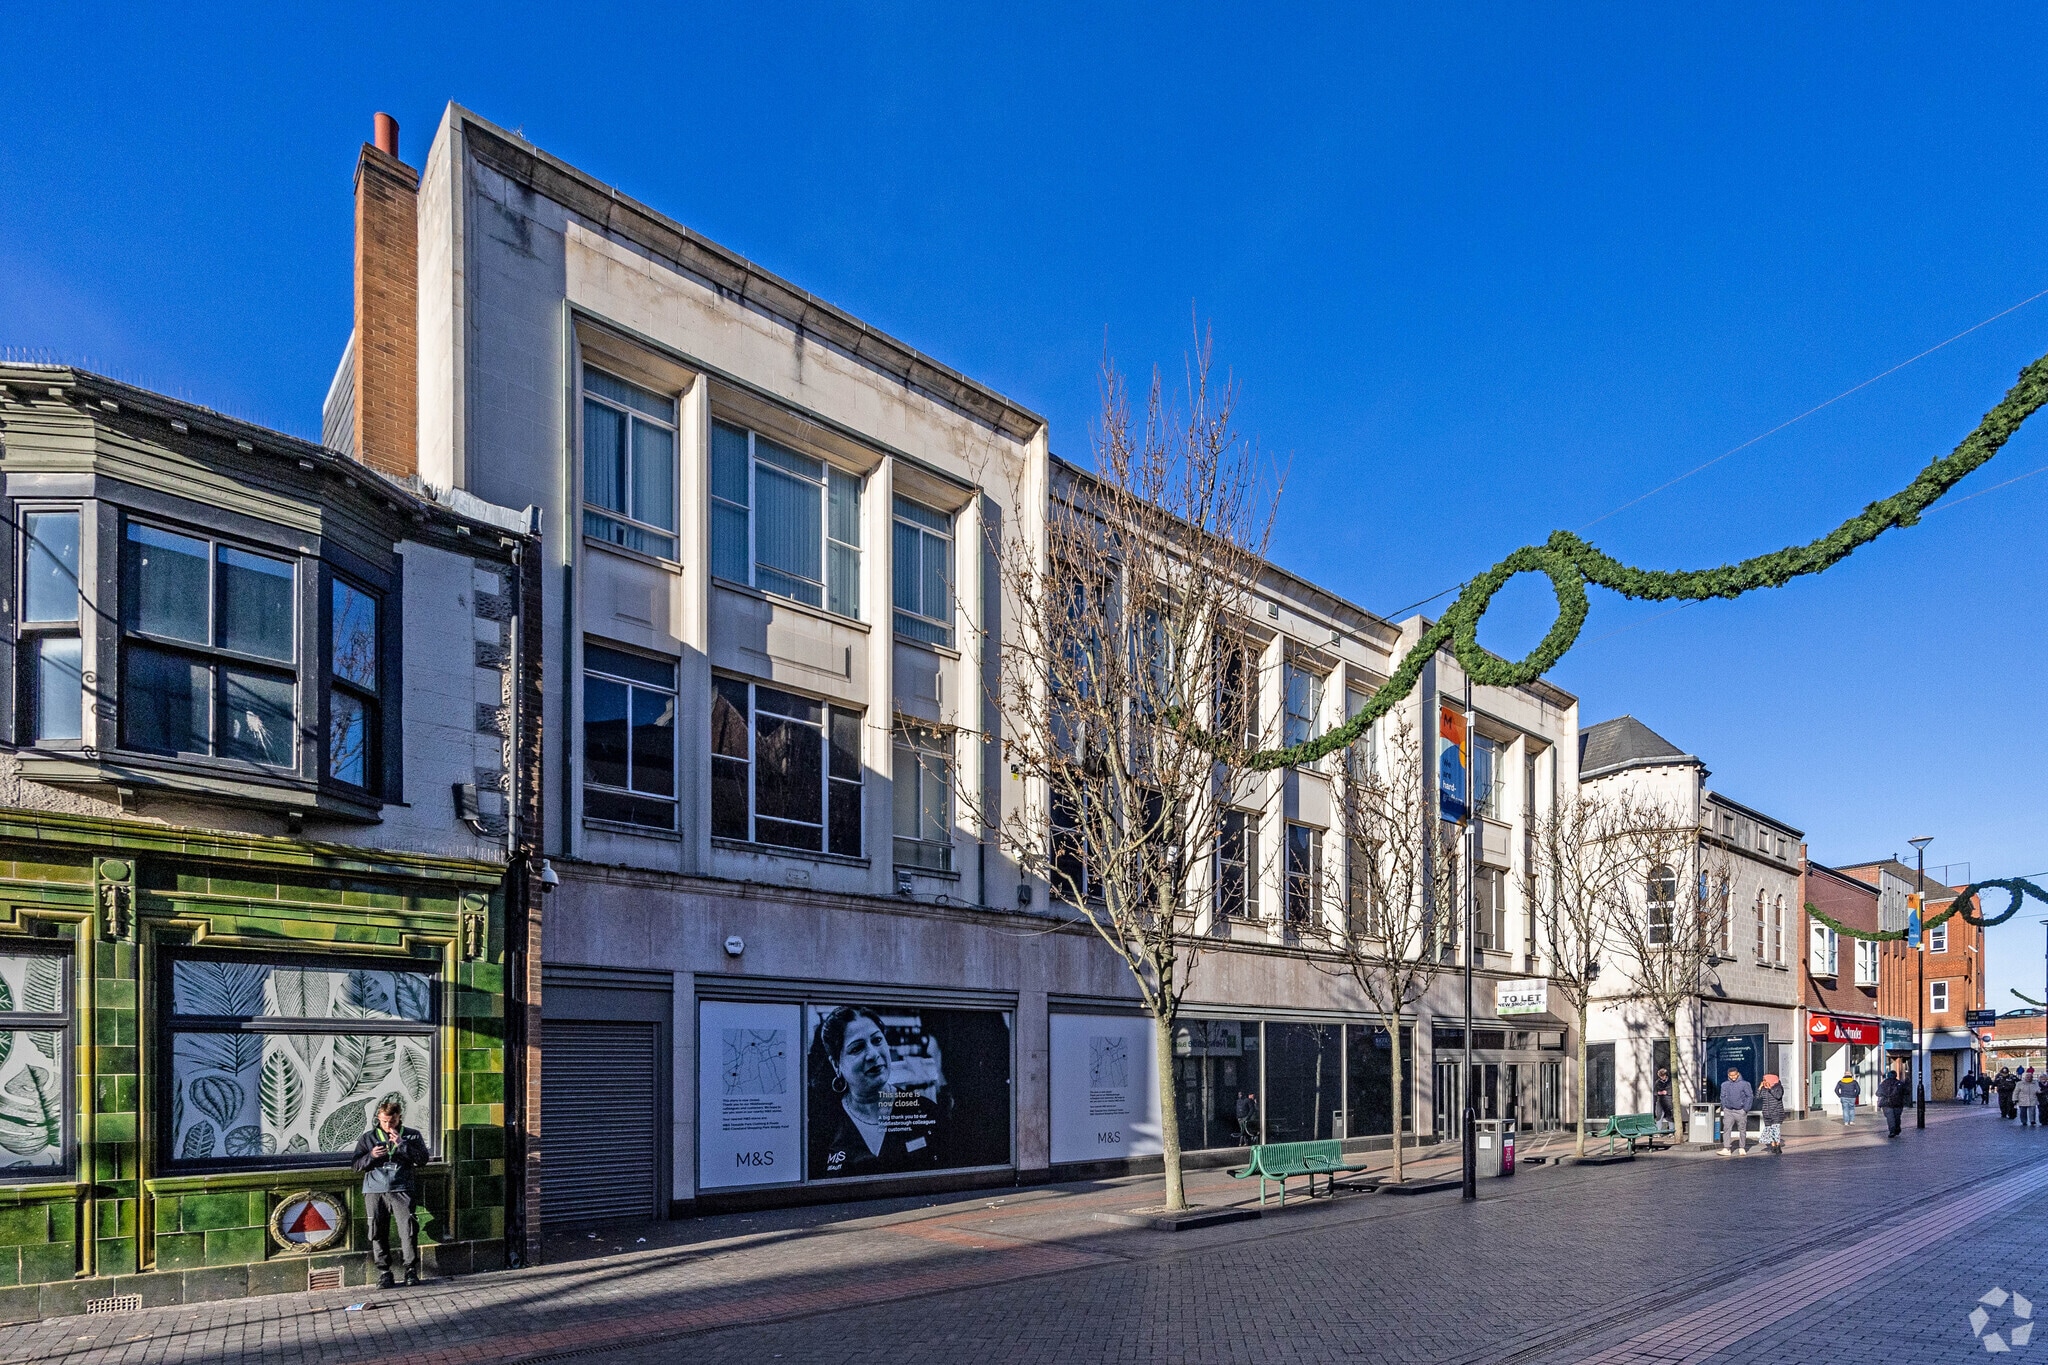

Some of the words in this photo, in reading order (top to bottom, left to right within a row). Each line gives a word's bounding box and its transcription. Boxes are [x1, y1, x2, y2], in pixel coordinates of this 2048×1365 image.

[1443, 713, 1453, 730] M
[1443, 759, 1451, 768] We
[1443, 780, 1456, 792] hard-
[895, 1099, 920, 1107] closed.
[1098, 1131, 1121, 1144] M&S
[736, 1151, 774, 1167] M&S
[827, 1151, 846, 1164] M&S
